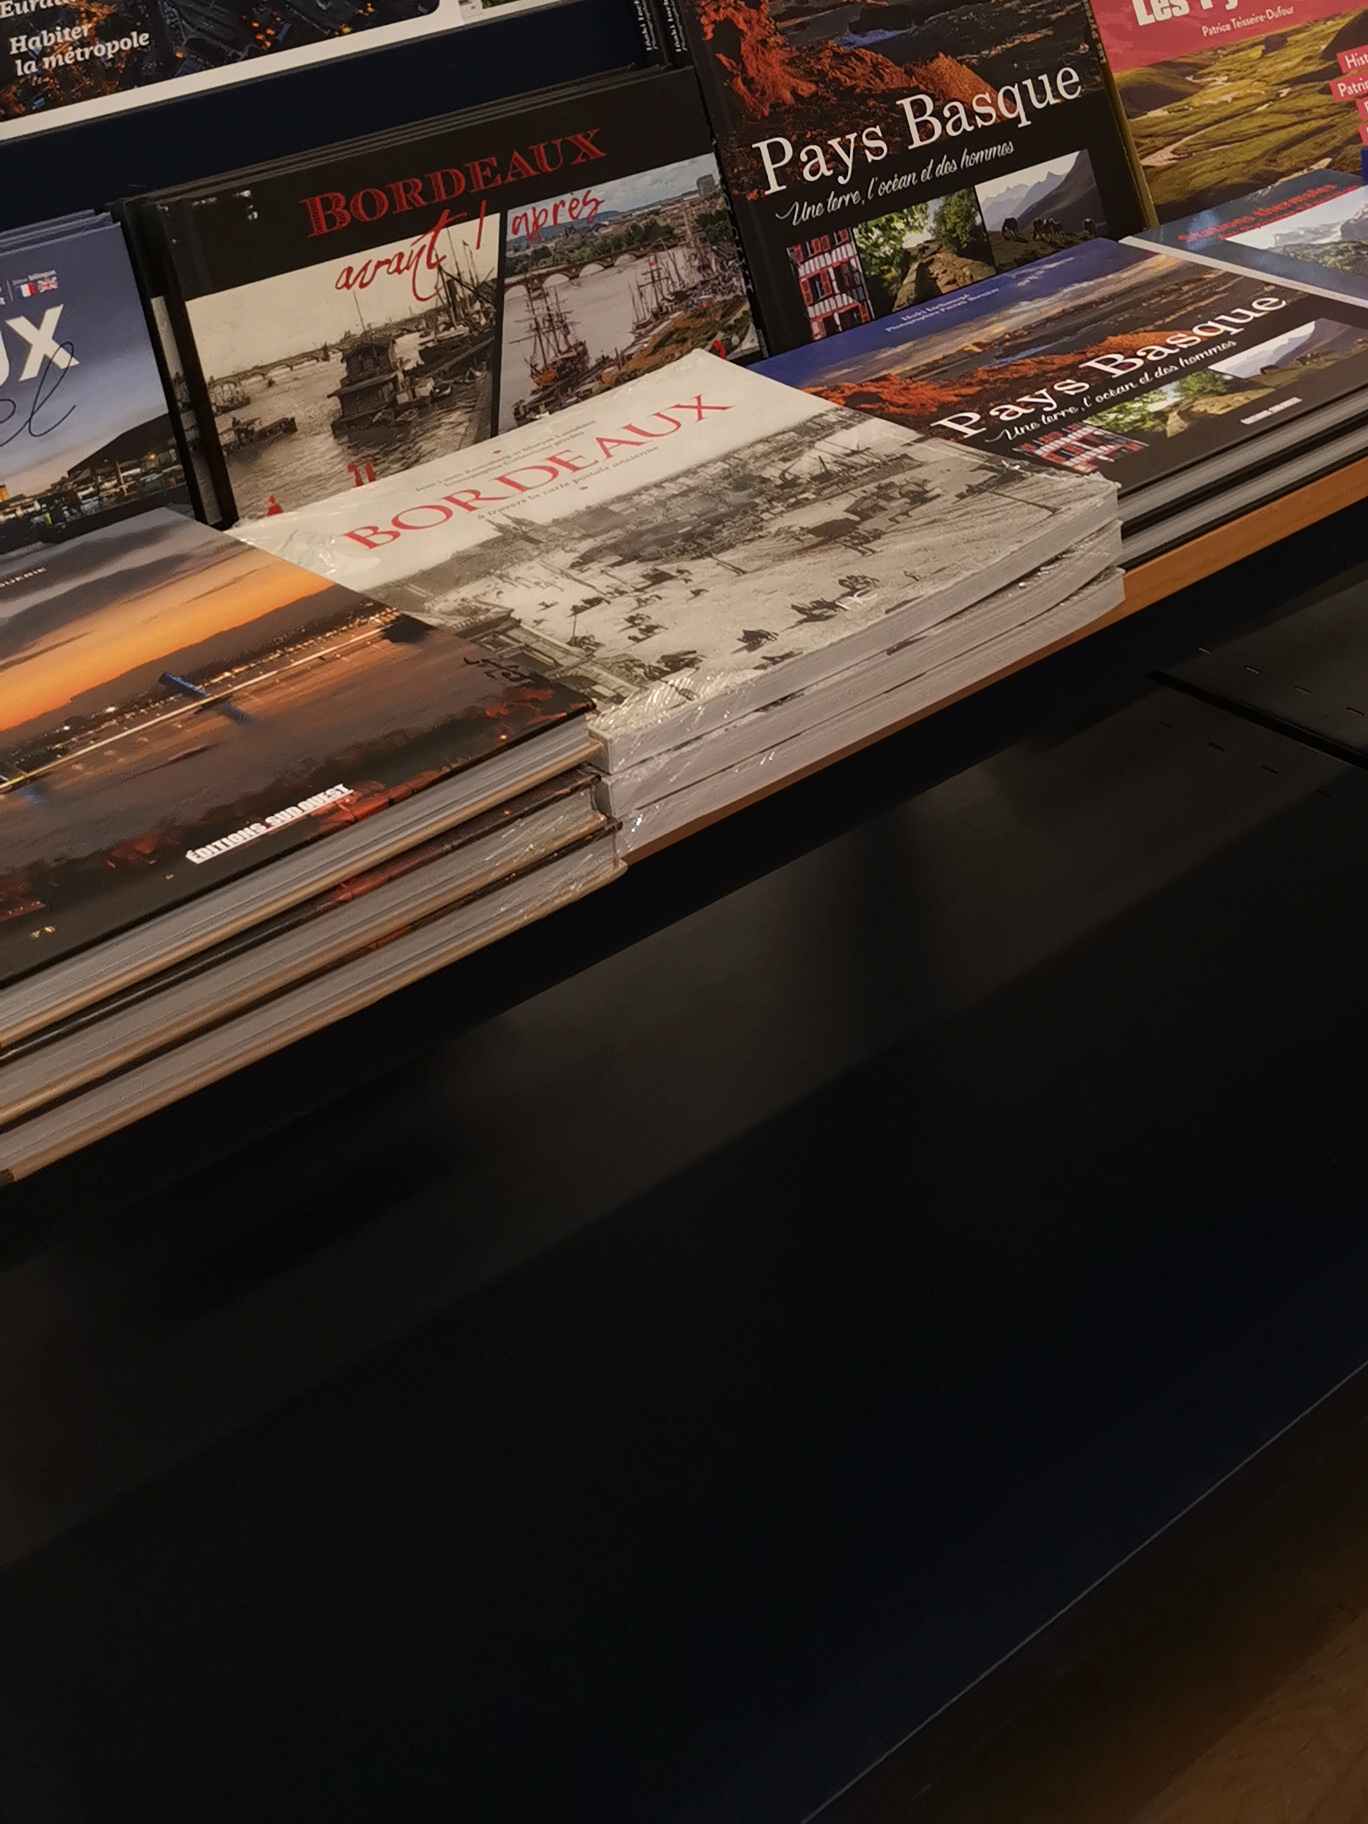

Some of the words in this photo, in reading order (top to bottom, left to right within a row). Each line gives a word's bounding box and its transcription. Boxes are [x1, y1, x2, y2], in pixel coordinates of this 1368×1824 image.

[9, 23, 92, 55] Habiter
[15, 59, 39, 77] la
[43, 31, 151, 70] métropole
[1202, 22, 1231, 38] Patrice
[752, 122, 889, 197] Pays
[896, 66, 1082, 150] Basque
[961, 140, 1015, 171] hommes
[301, 128, 607, 239] BORDEAUX
[511, 186, 606, 242] après
[930, 376, 1091, 439] Pays
[1079, 295, 1287, 380] Basque
[343, 393, 734, 551] BORDEAUX
